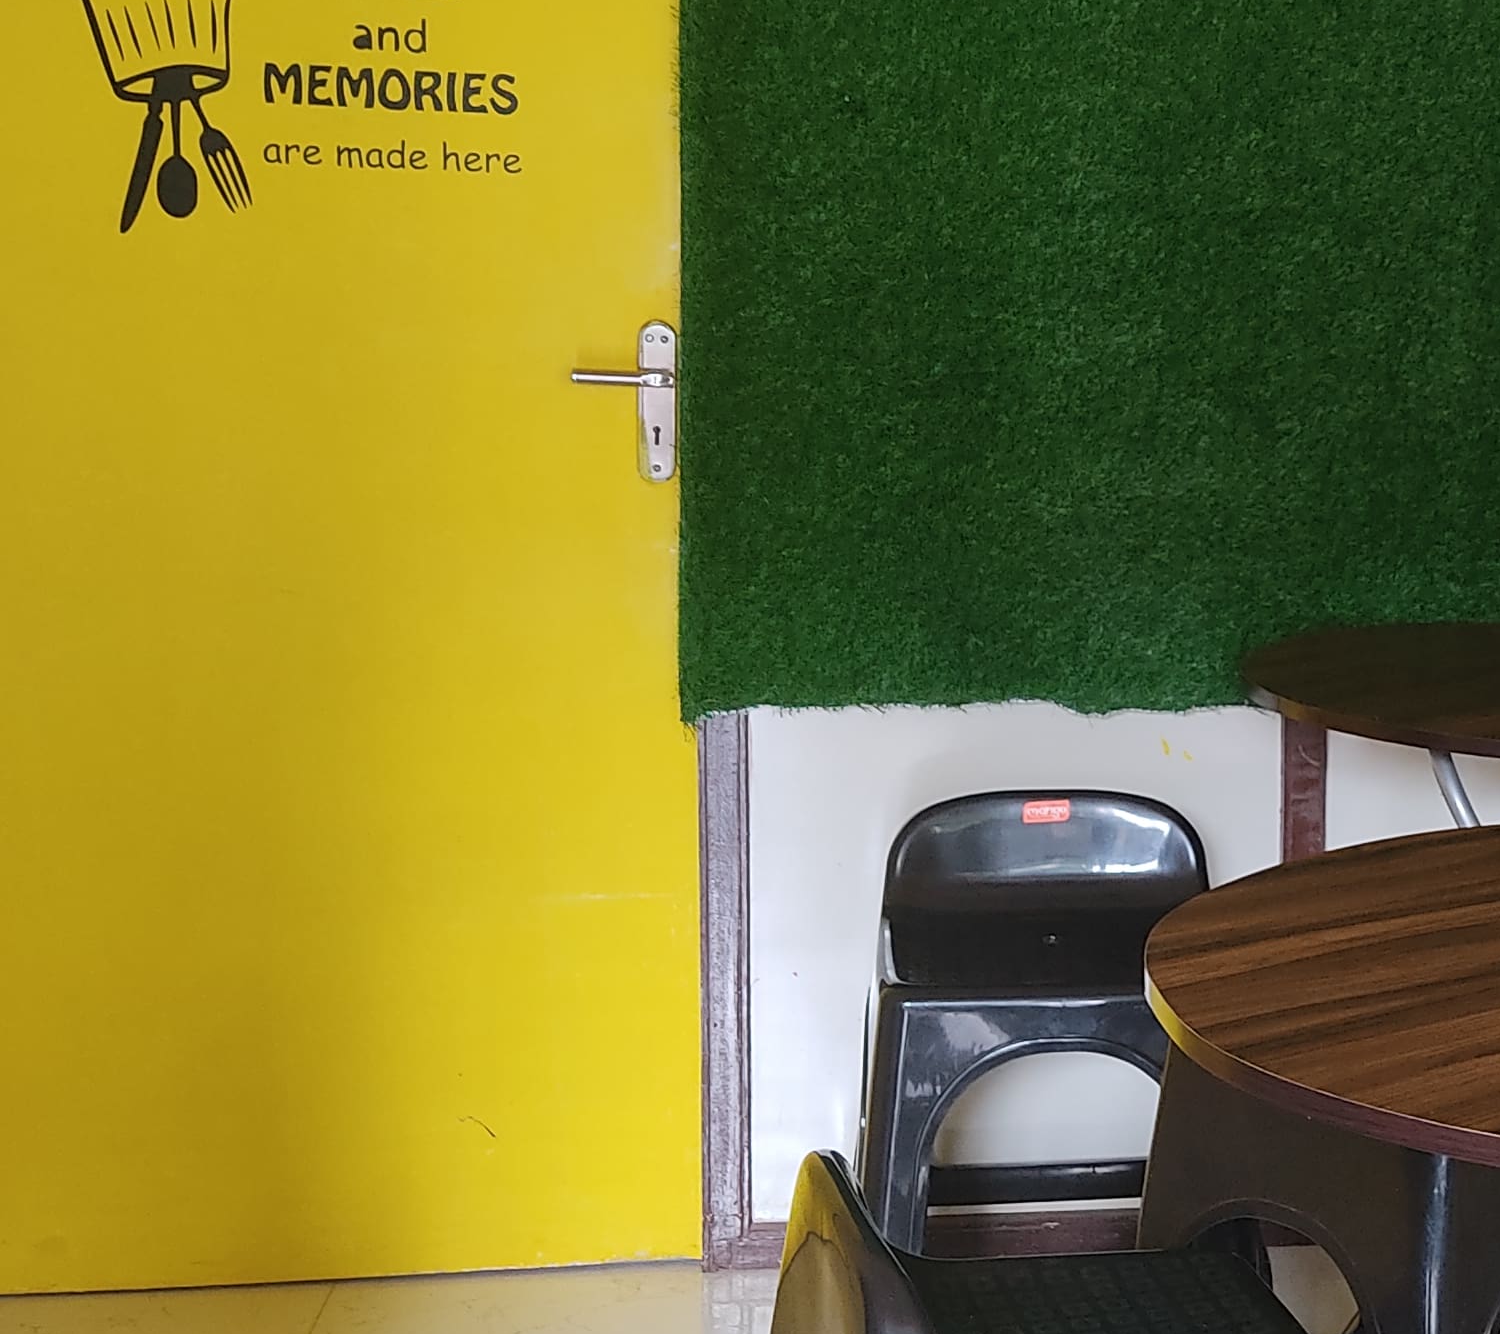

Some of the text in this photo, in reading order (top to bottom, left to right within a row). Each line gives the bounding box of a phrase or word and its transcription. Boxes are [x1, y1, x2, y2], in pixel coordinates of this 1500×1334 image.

[353, 19, 426, 53] and
[264, 63, 518, 115] MEMORIES
[264, 140, 522, 173] are made here
